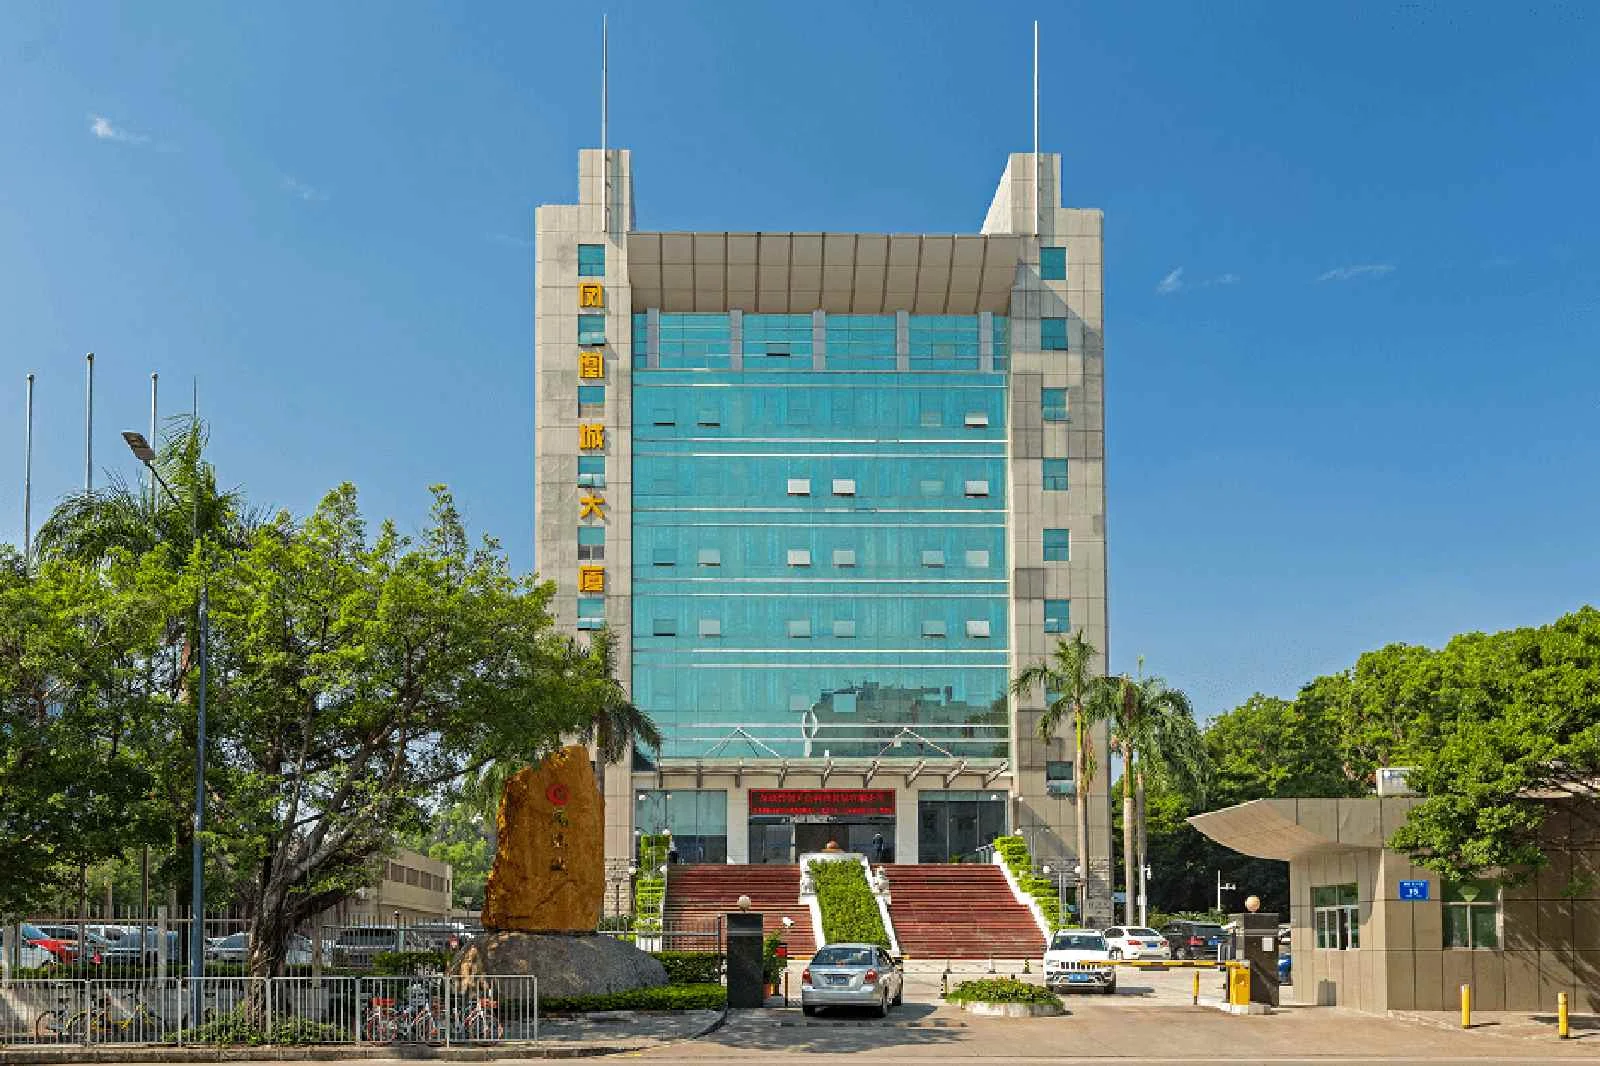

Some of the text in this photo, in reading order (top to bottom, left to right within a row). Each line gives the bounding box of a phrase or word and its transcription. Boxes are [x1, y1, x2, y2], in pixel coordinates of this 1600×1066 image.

[578, 283, 606, 593] 凤凰城大厦
